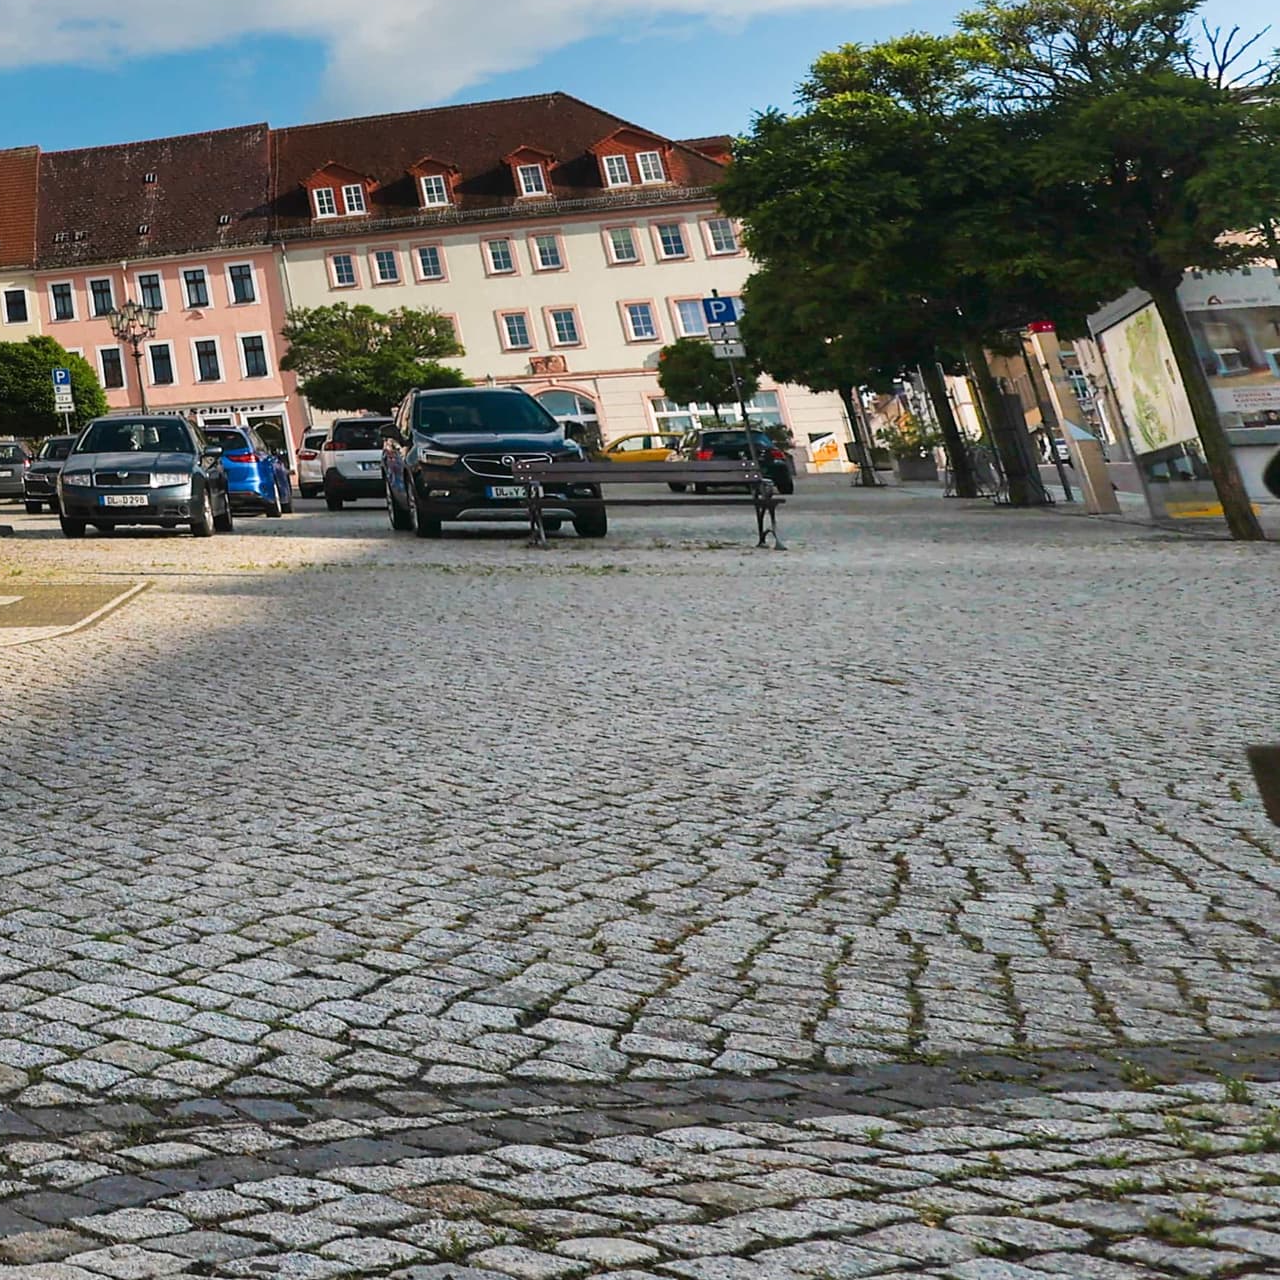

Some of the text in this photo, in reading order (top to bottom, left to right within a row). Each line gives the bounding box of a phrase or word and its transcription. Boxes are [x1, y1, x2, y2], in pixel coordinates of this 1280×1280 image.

[710, 301, 727, 320] P
[56, 371, 65, 383] P
[190, 405, 264, 415] Schubert
